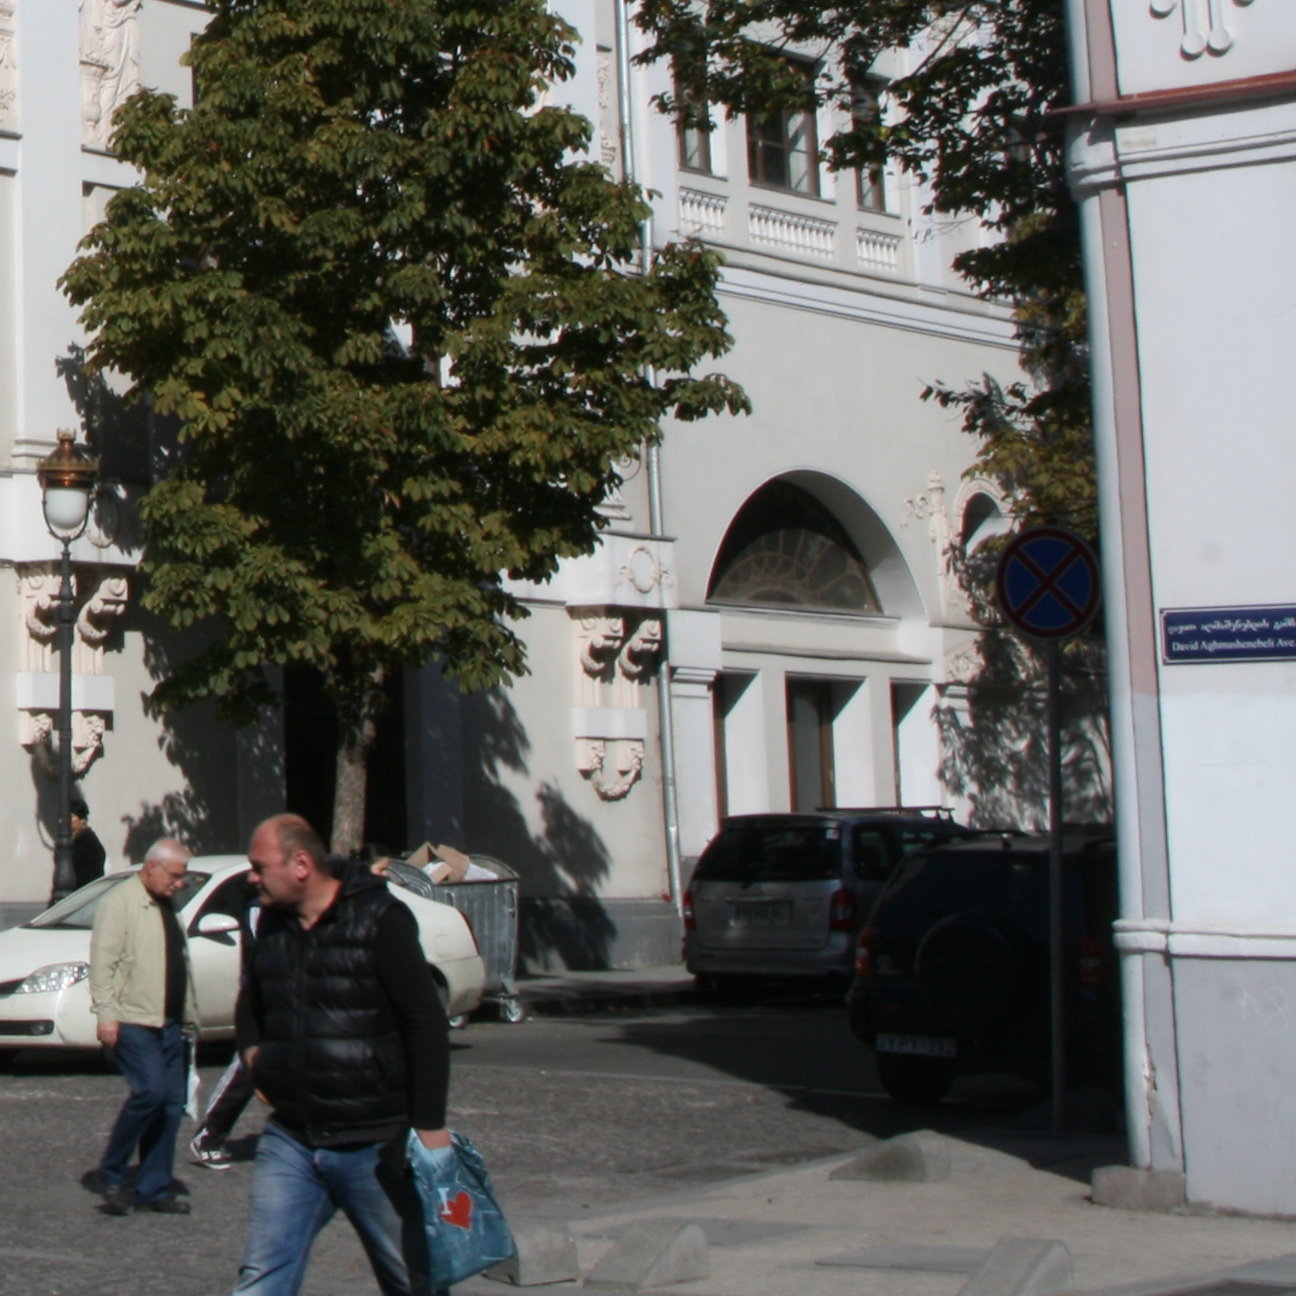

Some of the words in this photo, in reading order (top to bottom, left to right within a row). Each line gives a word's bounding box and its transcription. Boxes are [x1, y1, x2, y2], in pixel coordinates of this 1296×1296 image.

[1172, 641, 1199, 652] David
[1200, 638, 1274, 653] Aghmashenebeli
[437, 1187, 453, 1216] I
